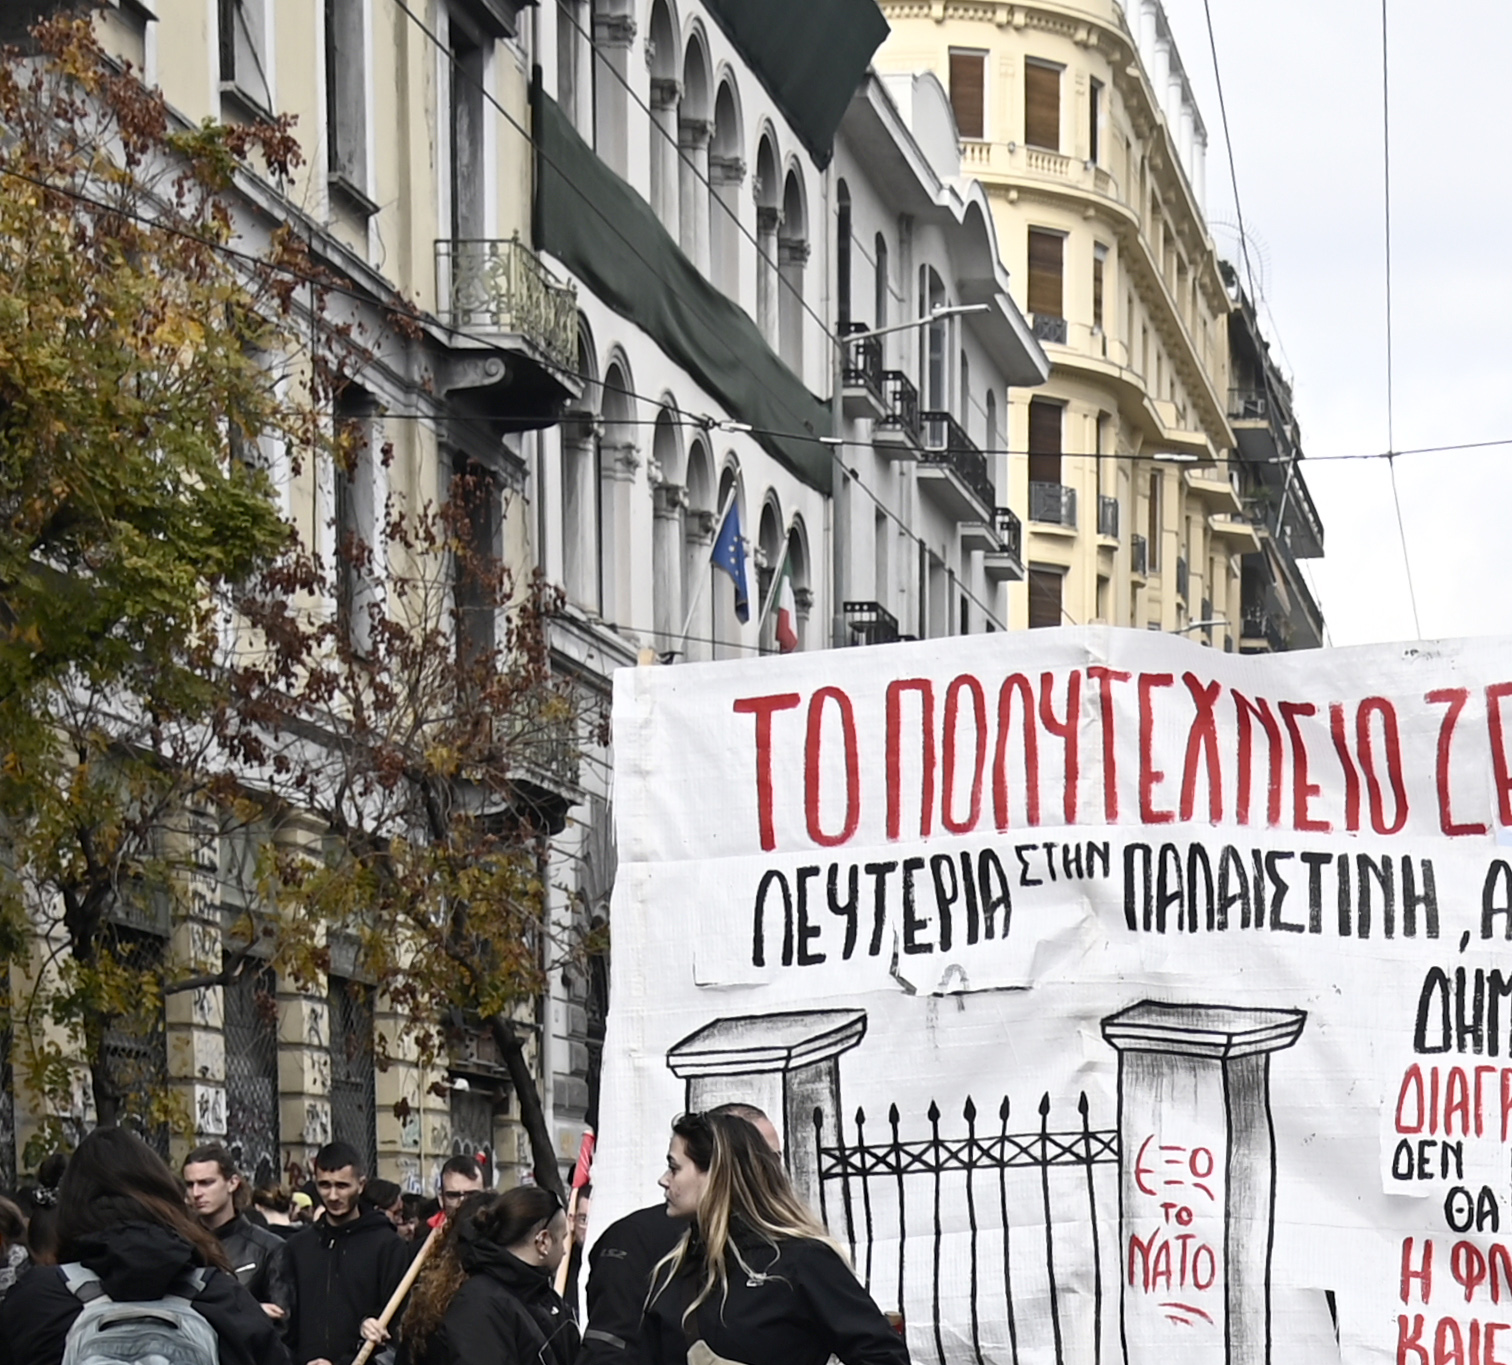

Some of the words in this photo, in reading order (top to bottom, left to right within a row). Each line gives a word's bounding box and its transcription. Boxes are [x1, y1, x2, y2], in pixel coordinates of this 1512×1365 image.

[732, 685, 860, 853] ΤΟ
[886, 665, 1409, 841] ΠΟΛΥΤΕΧΝΕΙΟ
[751, 846, 1012, 968] ΛΕΥΤΕΡΙΑ
[1016, 840, 1111, 888] ΣΤΗΝ
[1392, 1139, 1464, 1182] ΔΕΝ
[1159, 1201, 1194, 1226] ΤΟ
[1444, 1183, 1500, 1233] ΘΑ
[1127, 1231, 1215, 1293] ΝΑΤΟ
[1400, 1237, 1432, 1303] Η
